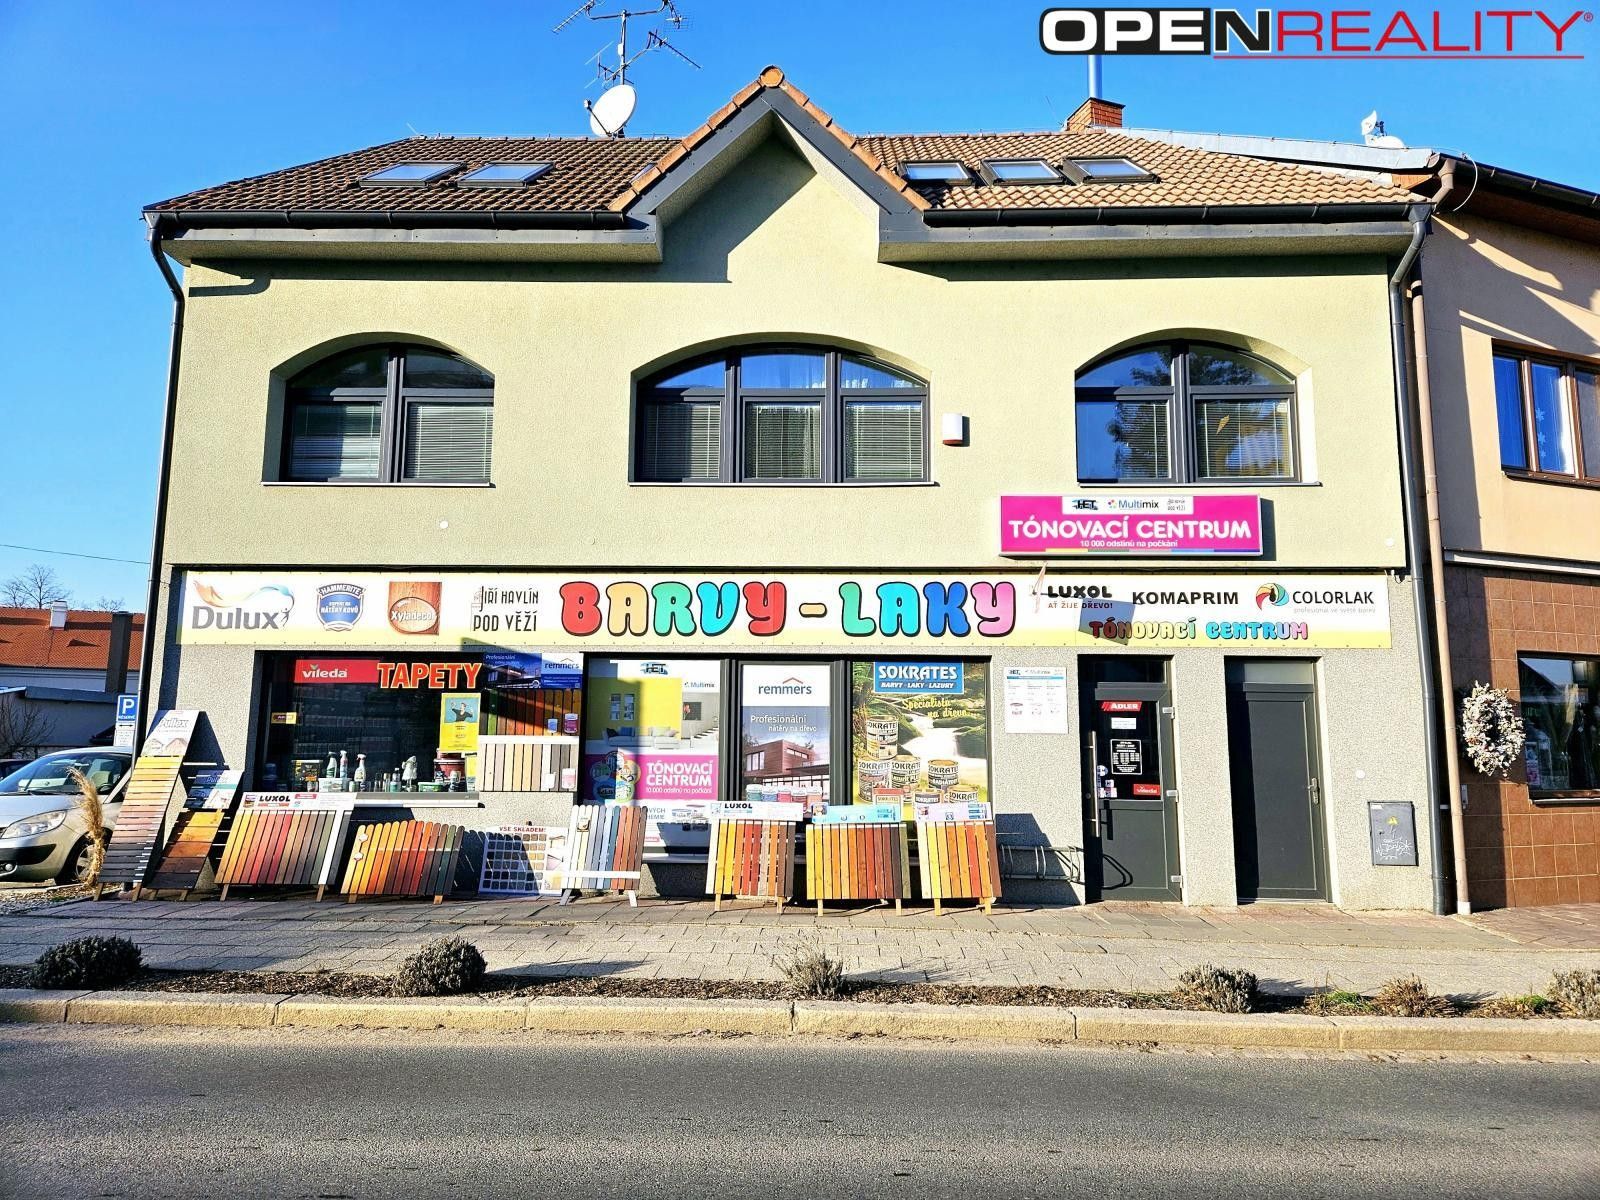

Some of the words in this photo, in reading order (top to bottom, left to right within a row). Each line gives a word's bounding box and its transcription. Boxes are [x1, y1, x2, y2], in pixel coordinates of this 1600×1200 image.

[1118, 499, 1159, 509] Multimix
[1008, 515, 1129, 539] TÓNOVACÍ
[1136, 520, 1252, 539] CENTRUM
[319, 583, 363, 597] HAMMERITE
[1047, 585, 1113, 599] LUXOL
[1292, 590, 1375, 605] COLORLAK
[479, 585, 498, 612] JIŘÍ
[501, 588, 539, 605] HAVLÍN
[1061, 600, 1079, 609] ŽIJE
[1081, 600, 1113, 609] DŘEVO!
[1132, 591, 1239, 606] KOMAPRIM
[559, 581, 788, 637] BARVY
[838, 581, 1017, 637] LAKY
[191, 605, 280, 630] Dulux
[473, 614, 499, 632] POD
[505, 610, 538, 632] VĚŽÍ
[1088, 616, 1198, 640] TÓNOVACÍ
[1205, 620, 1309, 640] CENTRUM
[302, 668, 348, 679] vileda
[544, 662, 580, 670] remmers
[878, 665, 958, 680] SOKRATES
[376, 662, 483, 690] TAPETY
[758, 685, 812, 695] remmers
[122, 698, 135, 715] P
[750, 714, 807, 724] Profesionální
[646, 760, 714, 775] TÓNOVACÍ
[646, 774, 712, 787] CENTRUM
